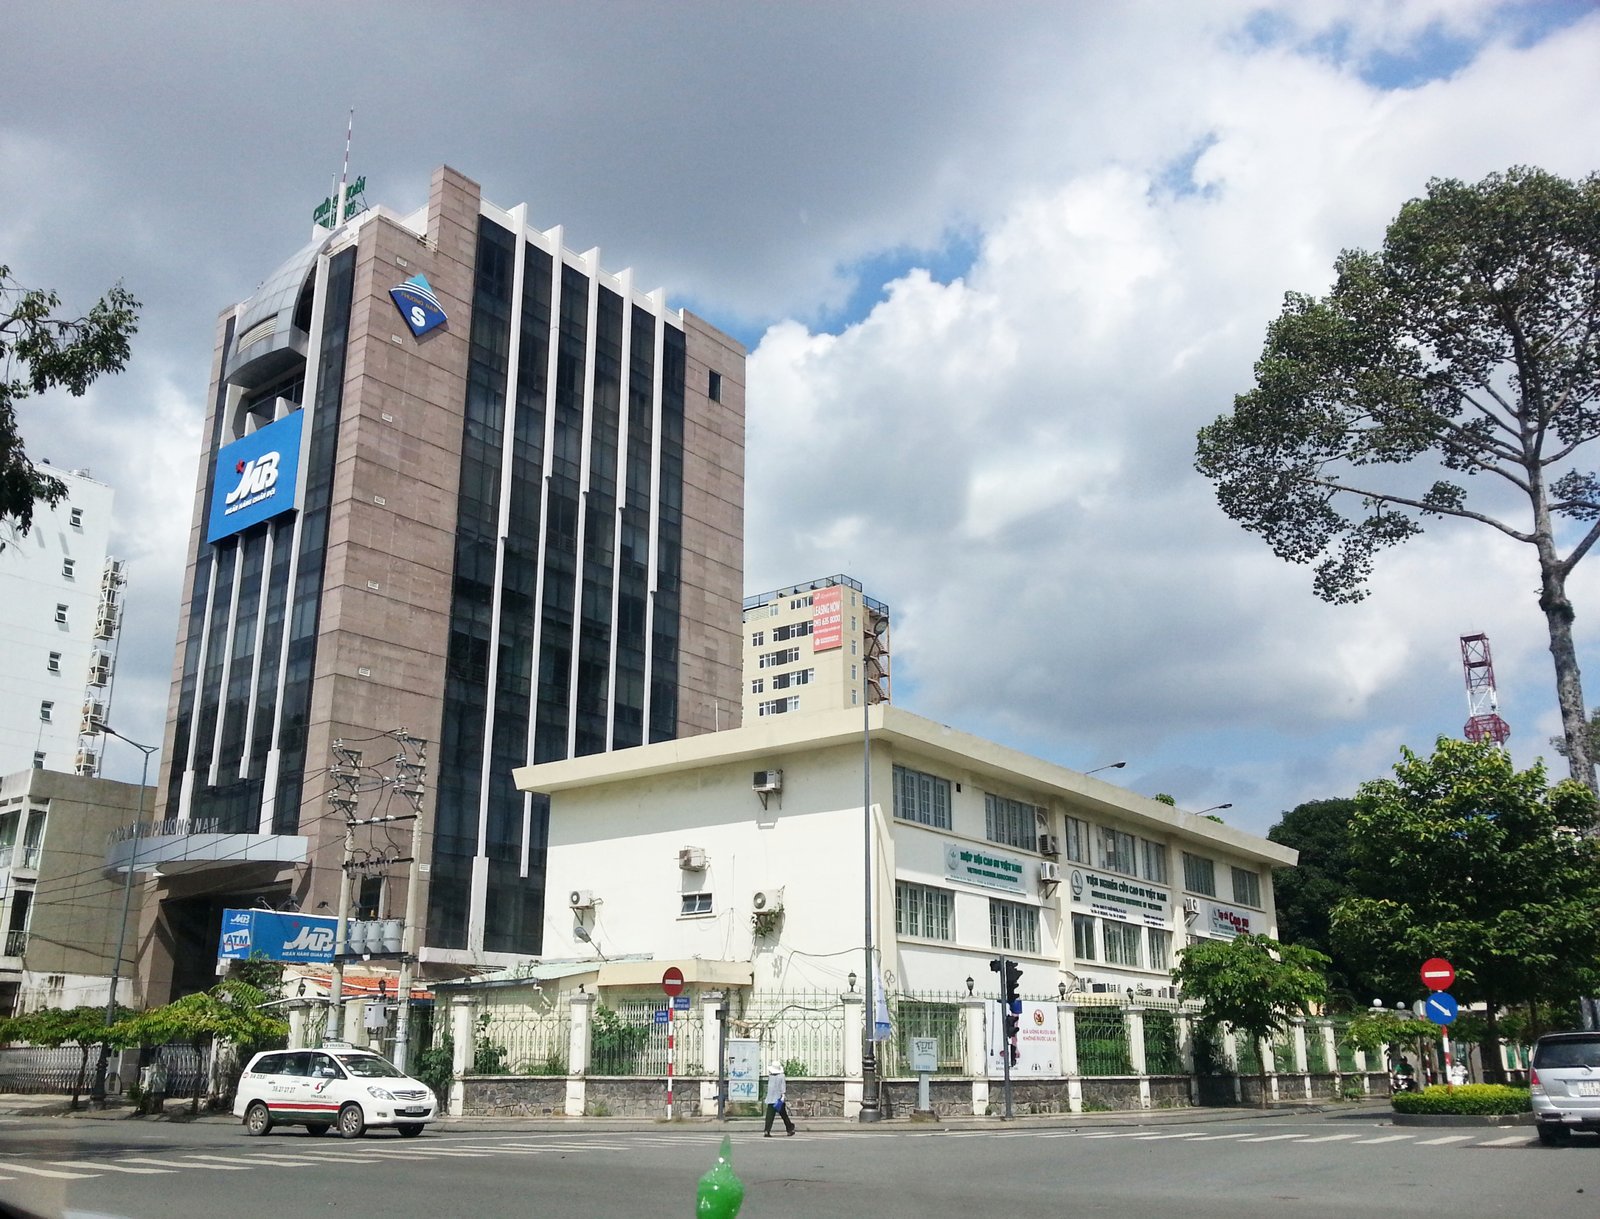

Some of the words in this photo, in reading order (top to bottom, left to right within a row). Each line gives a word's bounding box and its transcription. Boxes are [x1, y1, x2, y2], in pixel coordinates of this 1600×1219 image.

[411, 306, 426, 327] S
[225, 451, 280, 504] MB
[194, 817, 219, 834] NAM
[983, 857, 993, 867] CAO
[1086, 874, 1099, 888] VIỆN
[1129, 885, 1138, 896] CAO
[1146, 888, 1156, 901] VIỆT
[1229, 912, 1241, 925] Cao
[223, 934, 249, 952] ATM
[283, 926, 334, 952] MB
